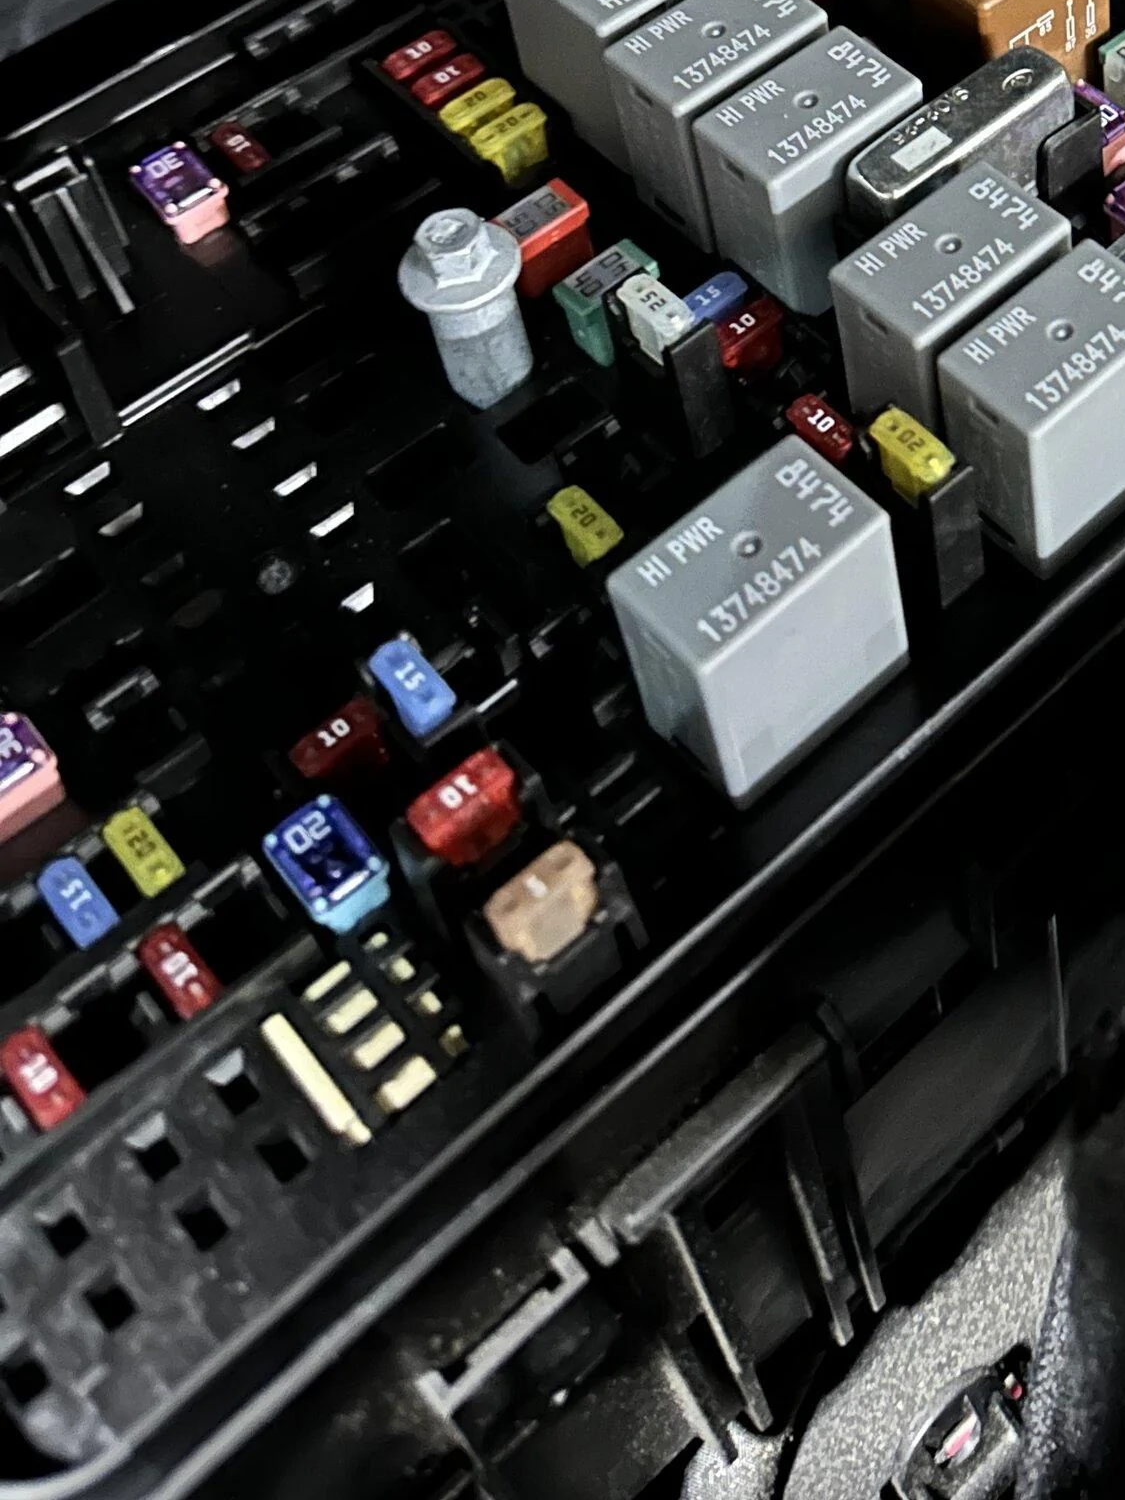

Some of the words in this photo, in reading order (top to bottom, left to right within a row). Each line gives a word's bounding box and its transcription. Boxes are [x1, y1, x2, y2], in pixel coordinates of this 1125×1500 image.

[405, 40, 432, 60] 10
[624, 35, 652, 55] HI
[650, 9, 694, 41] PWR
[432, 65, 461, 85] 10
[672, 23, 772, 90] 13748474
[827, 41, 892, 89] 8474
[715, 106, 744, 127] HI
[741, 78, 786, 111] PWR
[1100, 104, 1119, 128] 0
[766, 93, 867, 165] 13748474
[147, 151, 185, 179] 30
[968, 177, 1039, 230] 8474
[853, 251, 885, 276] HI
[879, 221, 928, 259] PWR
[640, 290, 667, 312] 25
[699, 285, 720, 306] 15
[911, 238, 1014, 319] 13748474
[728, 312, 757, 335] 10
[963, 338, 995, 366] HI
[989, 305, 1036, 347] PWR
[806, 408, 836, 433] 10
[775, 459, 854, 528] 8474
[636, 555, 673, 588] HI
[667, 515, 725, 564] PWR
[696, 536, 822, 642] 13748474
[393, 661, 428, 691] 15
[317, 718, 351, 747] 10
[437, 774, 478, 808] 10
[282, 810, 331, 855] 20
